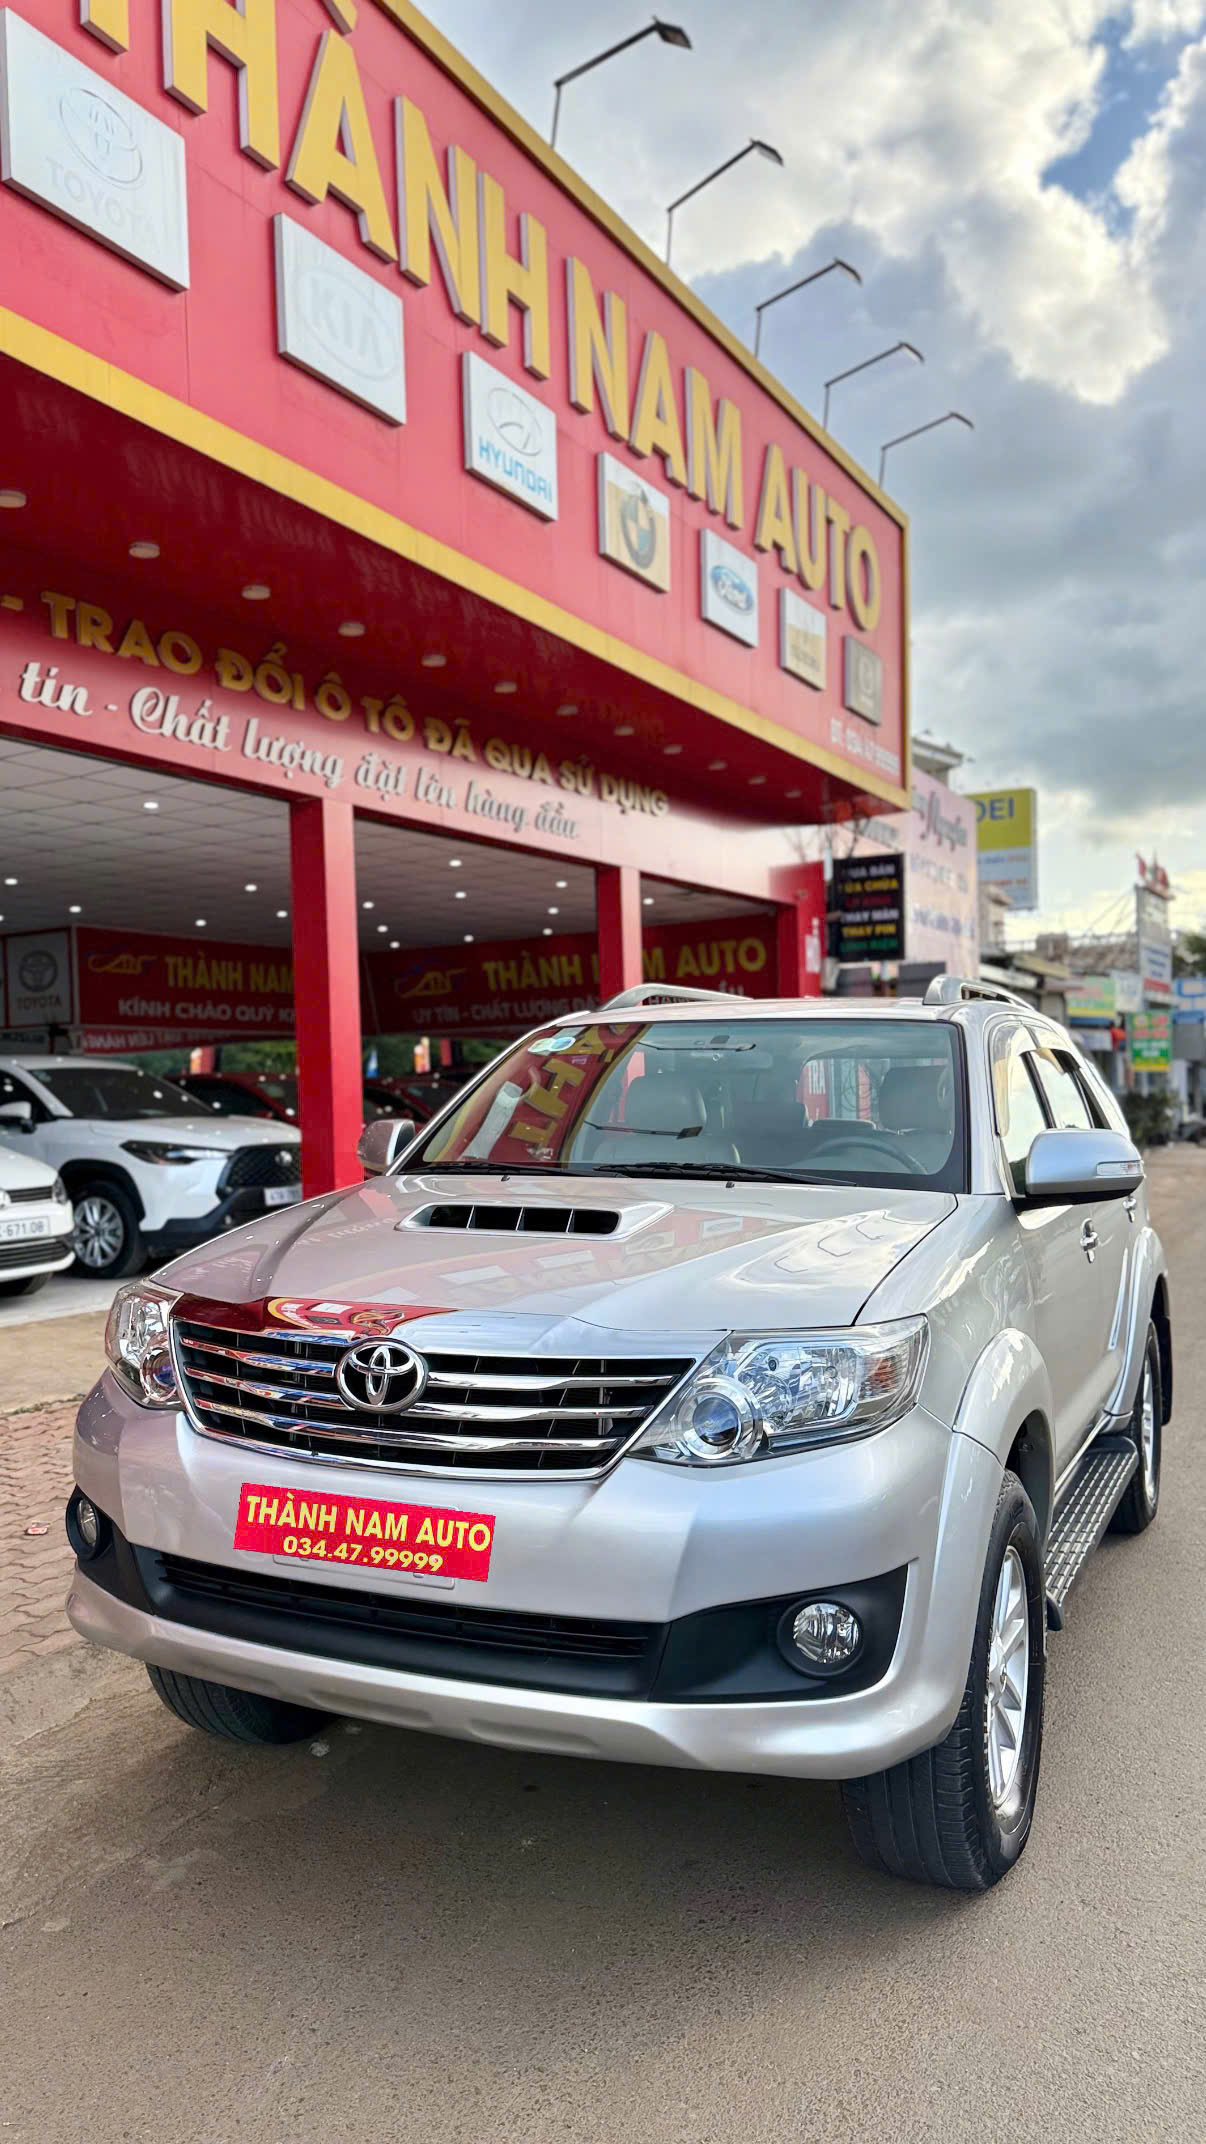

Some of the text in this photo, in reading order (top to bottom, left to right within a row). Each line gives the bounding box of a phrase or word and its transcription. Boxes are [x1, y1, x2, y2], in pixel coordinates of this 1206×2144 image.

[80, 0, 882, 634] HÀNH NAM AUTO
[478, 435, 553, 503] HYUNDAI
[41, 591, 202, 675] TRAO
[215, 641, 305, 711] ĐỔI
[315, 671, 352, 721] Ô
[360, 694, 415, 742] TÔ
[424, 717, 478, 763] ĐÃ
[484, 737, 552, 785] QUA
[559, 753, 595, 797] SỬ
[598, 773, 670, 817] DỤNG
[19, 662, 93, 716] tín
[130, 686, 232, 752] Chất
[242, 717, 344, 789] lượng
[414, 766, 457, 809] lên
[464, 779, 531, 832] hàng
[533, 802, 580, 839] đầu
[164, 952, 243, 991] THÀNH
[482, 949, 582, 991] THÀNH
[676, 936, 767, 976] AUTO
[16, 995, 62, 1011] TOYOTA
[118, 996, 171, 1018] KÍNH
[174, 998, 231, 1020] CHÀO
[235, 1003, 274, 1023] QUÝ
